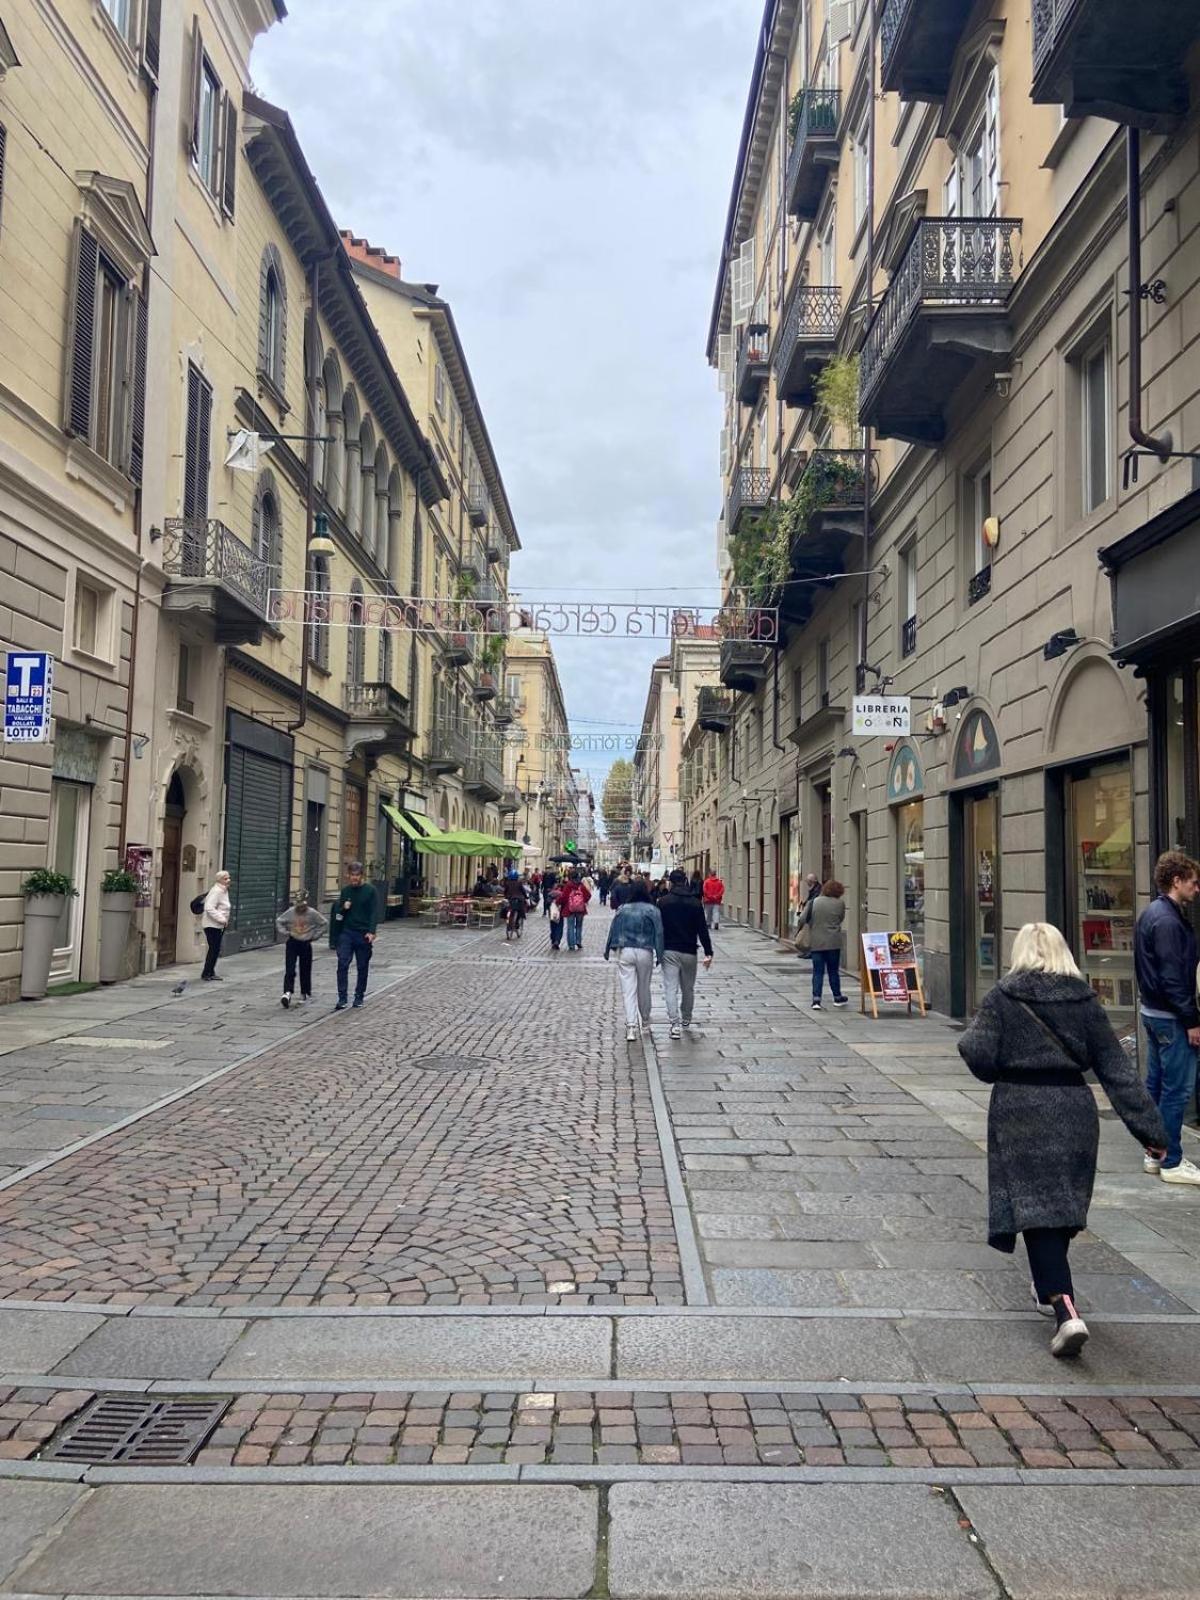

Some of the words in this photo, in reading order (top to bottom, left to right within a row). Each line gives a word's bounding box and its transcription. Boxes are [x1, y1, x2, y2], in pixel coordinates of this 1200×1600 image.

[13, 657, 40, 697] T
[8, 704, 43, 713] TABACCHI
[856, 705, 908, 713] LIBRERIA
[7, 727, 40, 737] LOTTO
